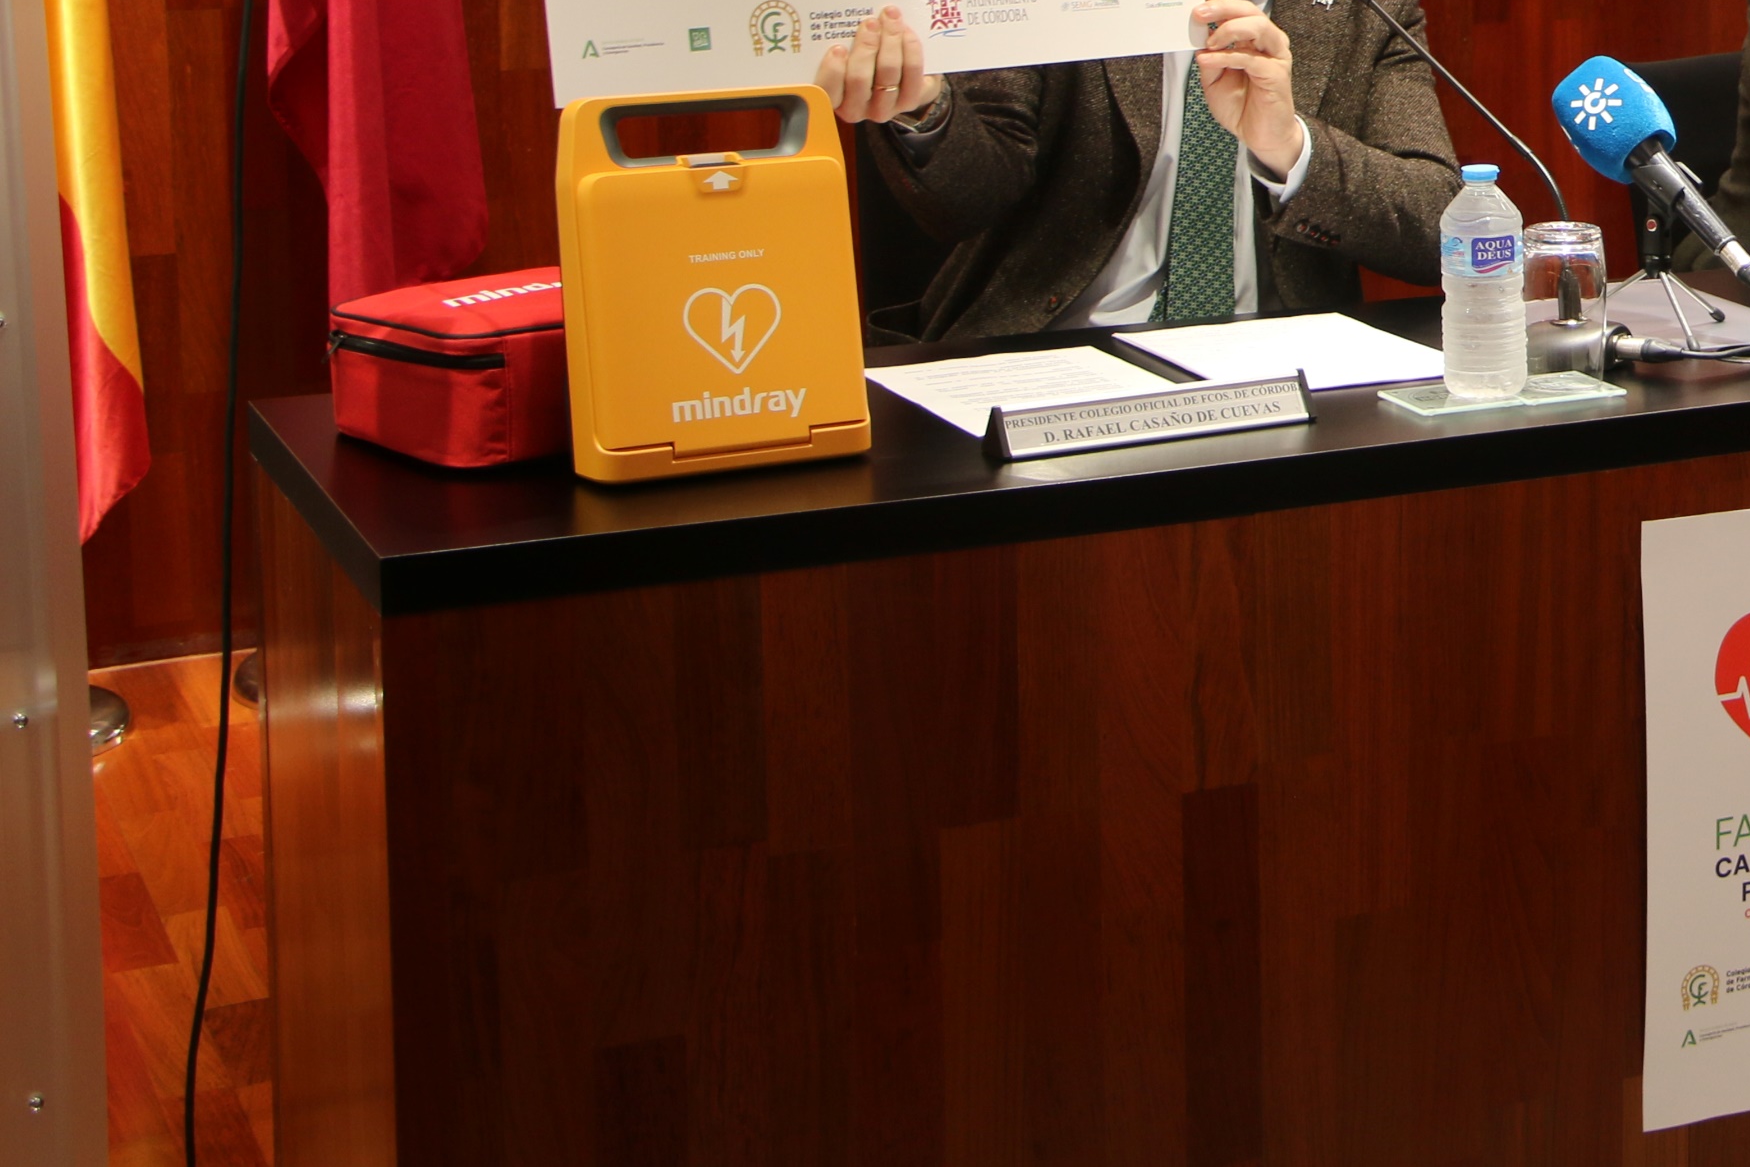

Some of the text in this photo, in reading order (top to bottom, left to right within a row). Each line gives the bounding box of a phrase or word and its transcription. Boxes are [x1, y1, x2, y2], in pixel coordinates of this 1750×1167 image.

[809, 7, 874, 21] Colegio Oficial
[968, 10, 1029, 26] DE CÓRDOBA
[810, 19, 862, 30] de Farmacé
[811, 30, 857, 40] de Córdob
[1475, 239, 1513, 252] AQUA
[688, 248, 765, 263] TRAINING ONLY
[1477, 249, 1512, 261] DEUS
[672, 386, 807, 423] mindray
[1005, 382, 1301, 430] PRESIDENTE COLEGIO OFICIAL DE FCOS. DE CÓRDOB
[1044, 400, 1281, 444] D. RAFAEL CASAÑO DE CUEVAS
[1726, 978, 1734, 986] de
[1726, 986, 1734, 994] de
